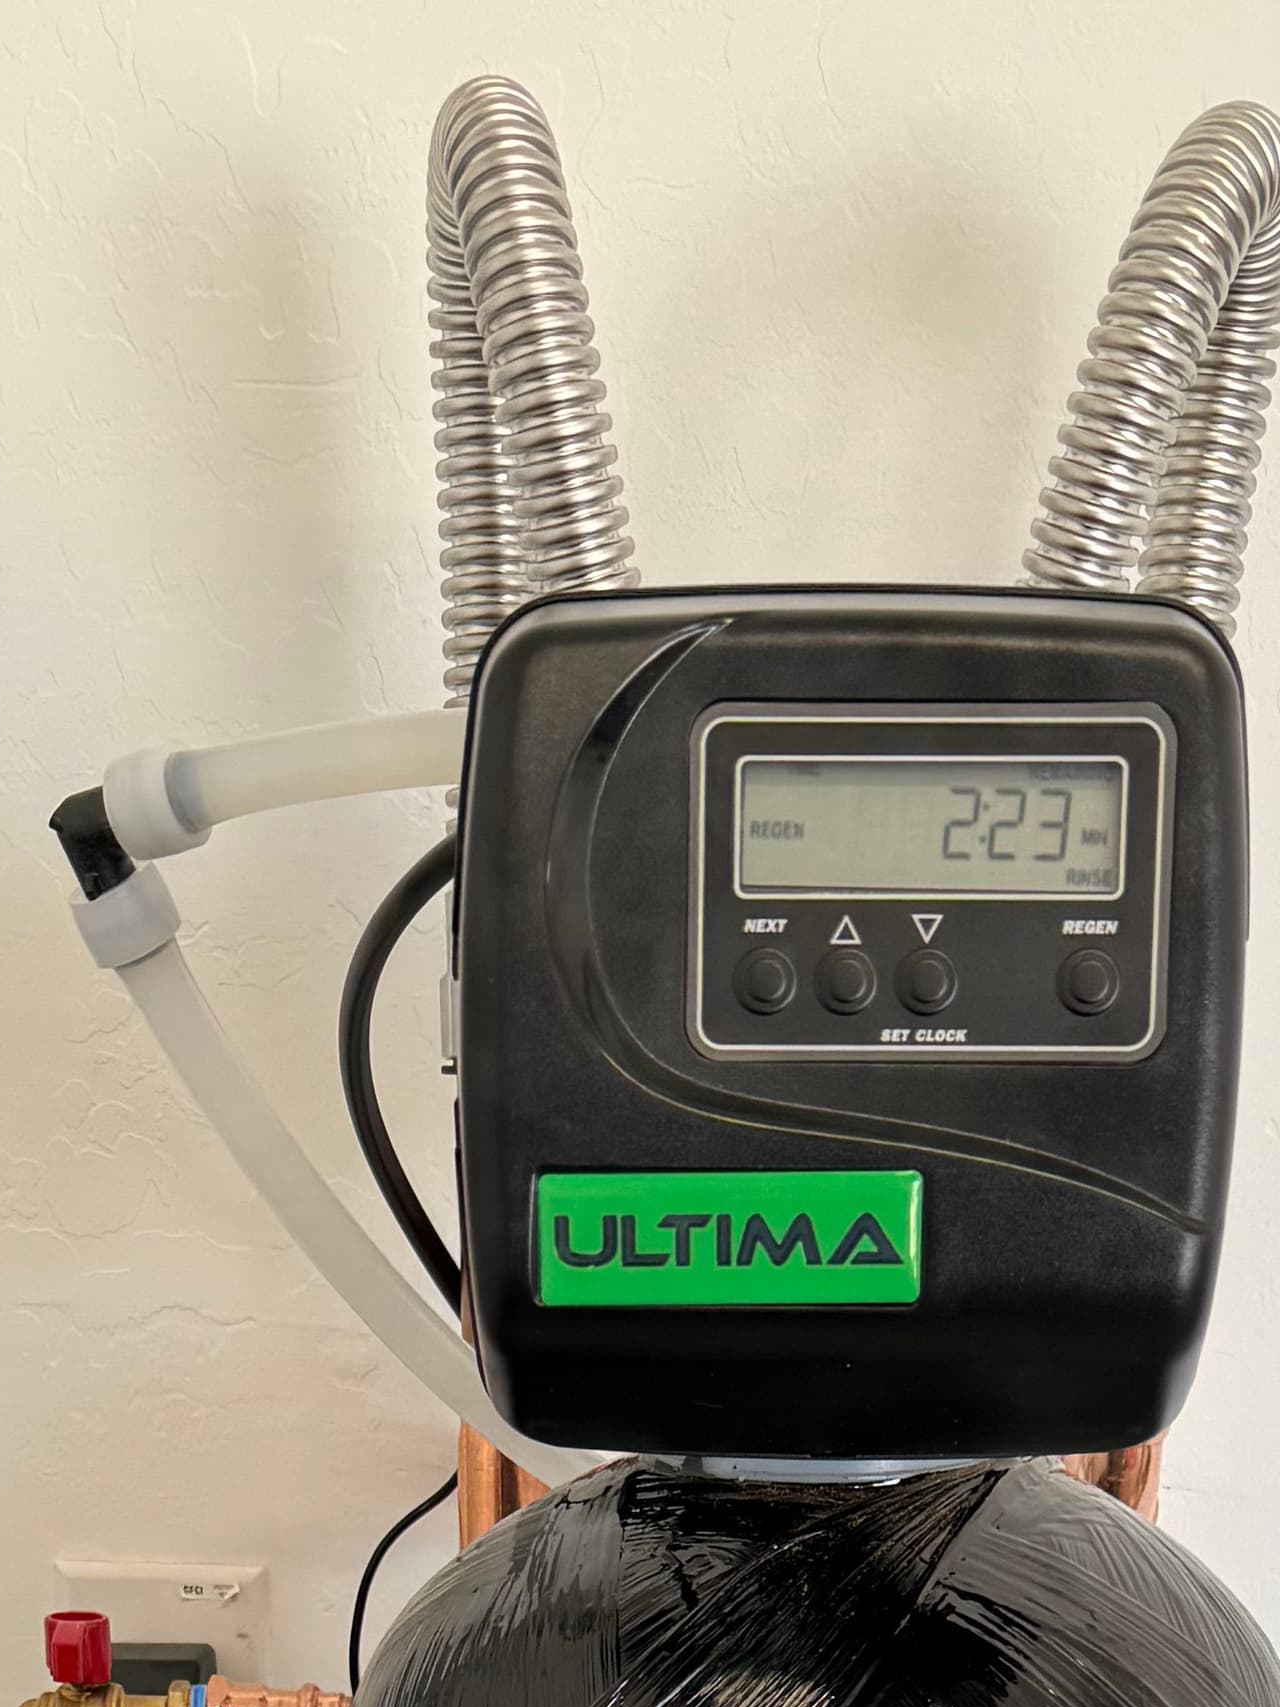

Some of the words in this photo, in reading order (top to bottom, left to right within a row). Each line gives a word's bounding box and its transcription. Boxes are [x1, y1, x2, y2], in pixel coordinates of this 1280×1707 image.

[749, 819, 805, 841] REGEN
[941, 785, 1072, 863] 2:23
[1081, 826, 1109, 847] MIN
[1066, 867, 1114, 888] RINSE
[743, 919, 787, 934] NEXT
[1062, 920, 1118, 936] REGEN
[880, 1029, 910, 1043] SET
[915, 1029, 968, 1043] CLOCK
[553, 1212, 905, 1269] ULTIMA
